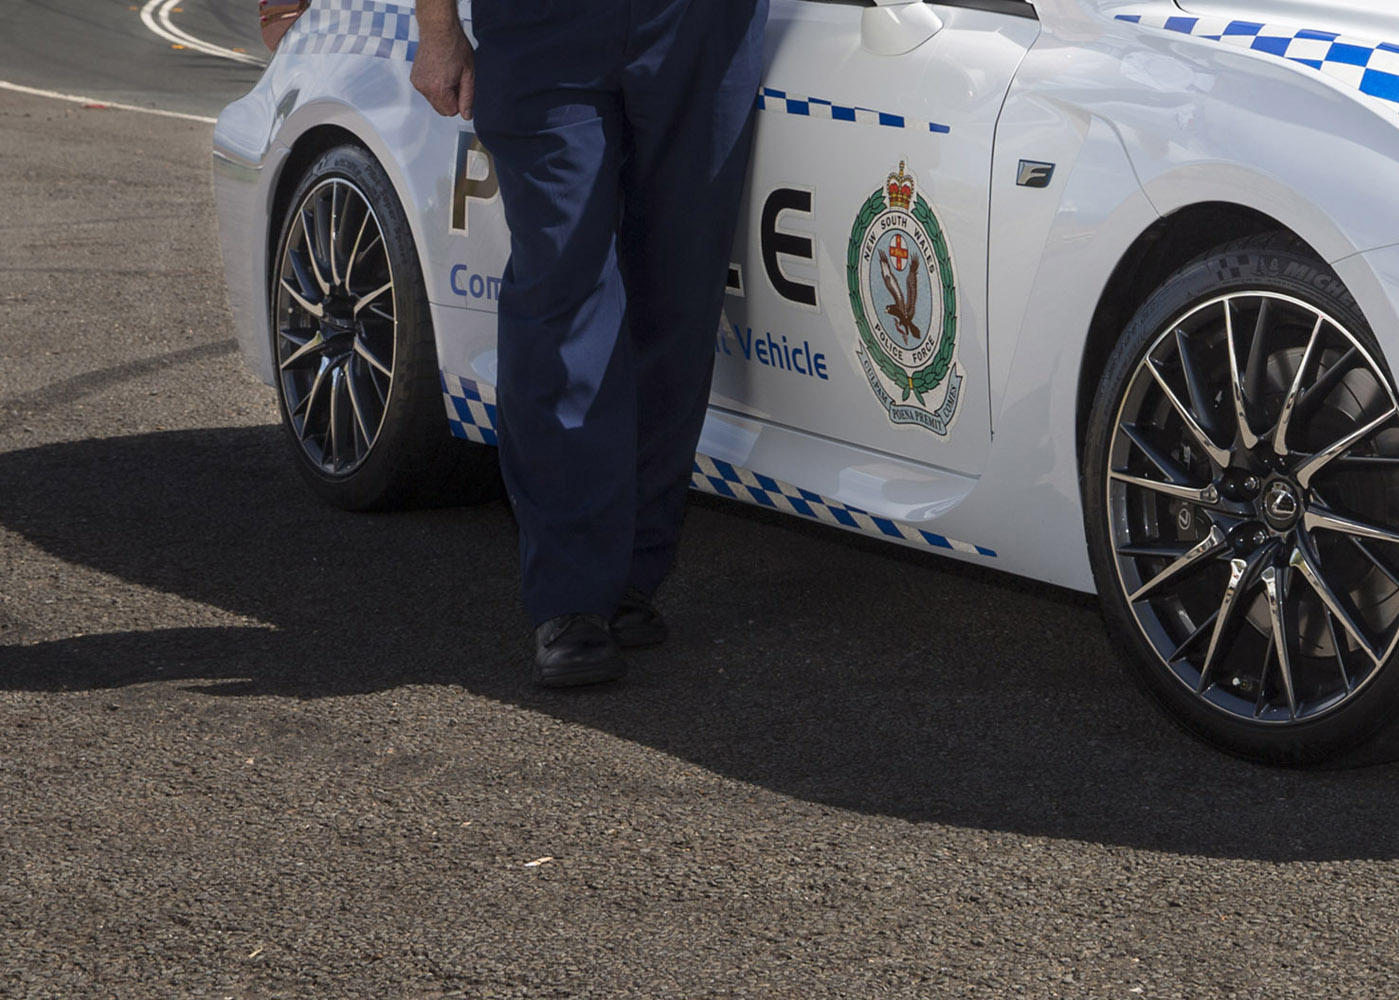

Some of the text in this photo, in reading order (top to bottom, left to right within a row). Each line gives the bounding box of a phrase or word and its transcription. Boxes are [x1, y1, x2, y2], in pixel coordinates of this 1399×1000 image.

[864, 215, 935, 274] NEW SOUTH WALES
[733, 322, 829, 380] Vehicle
[875, 323, 935, 364] POLICE FORCE
